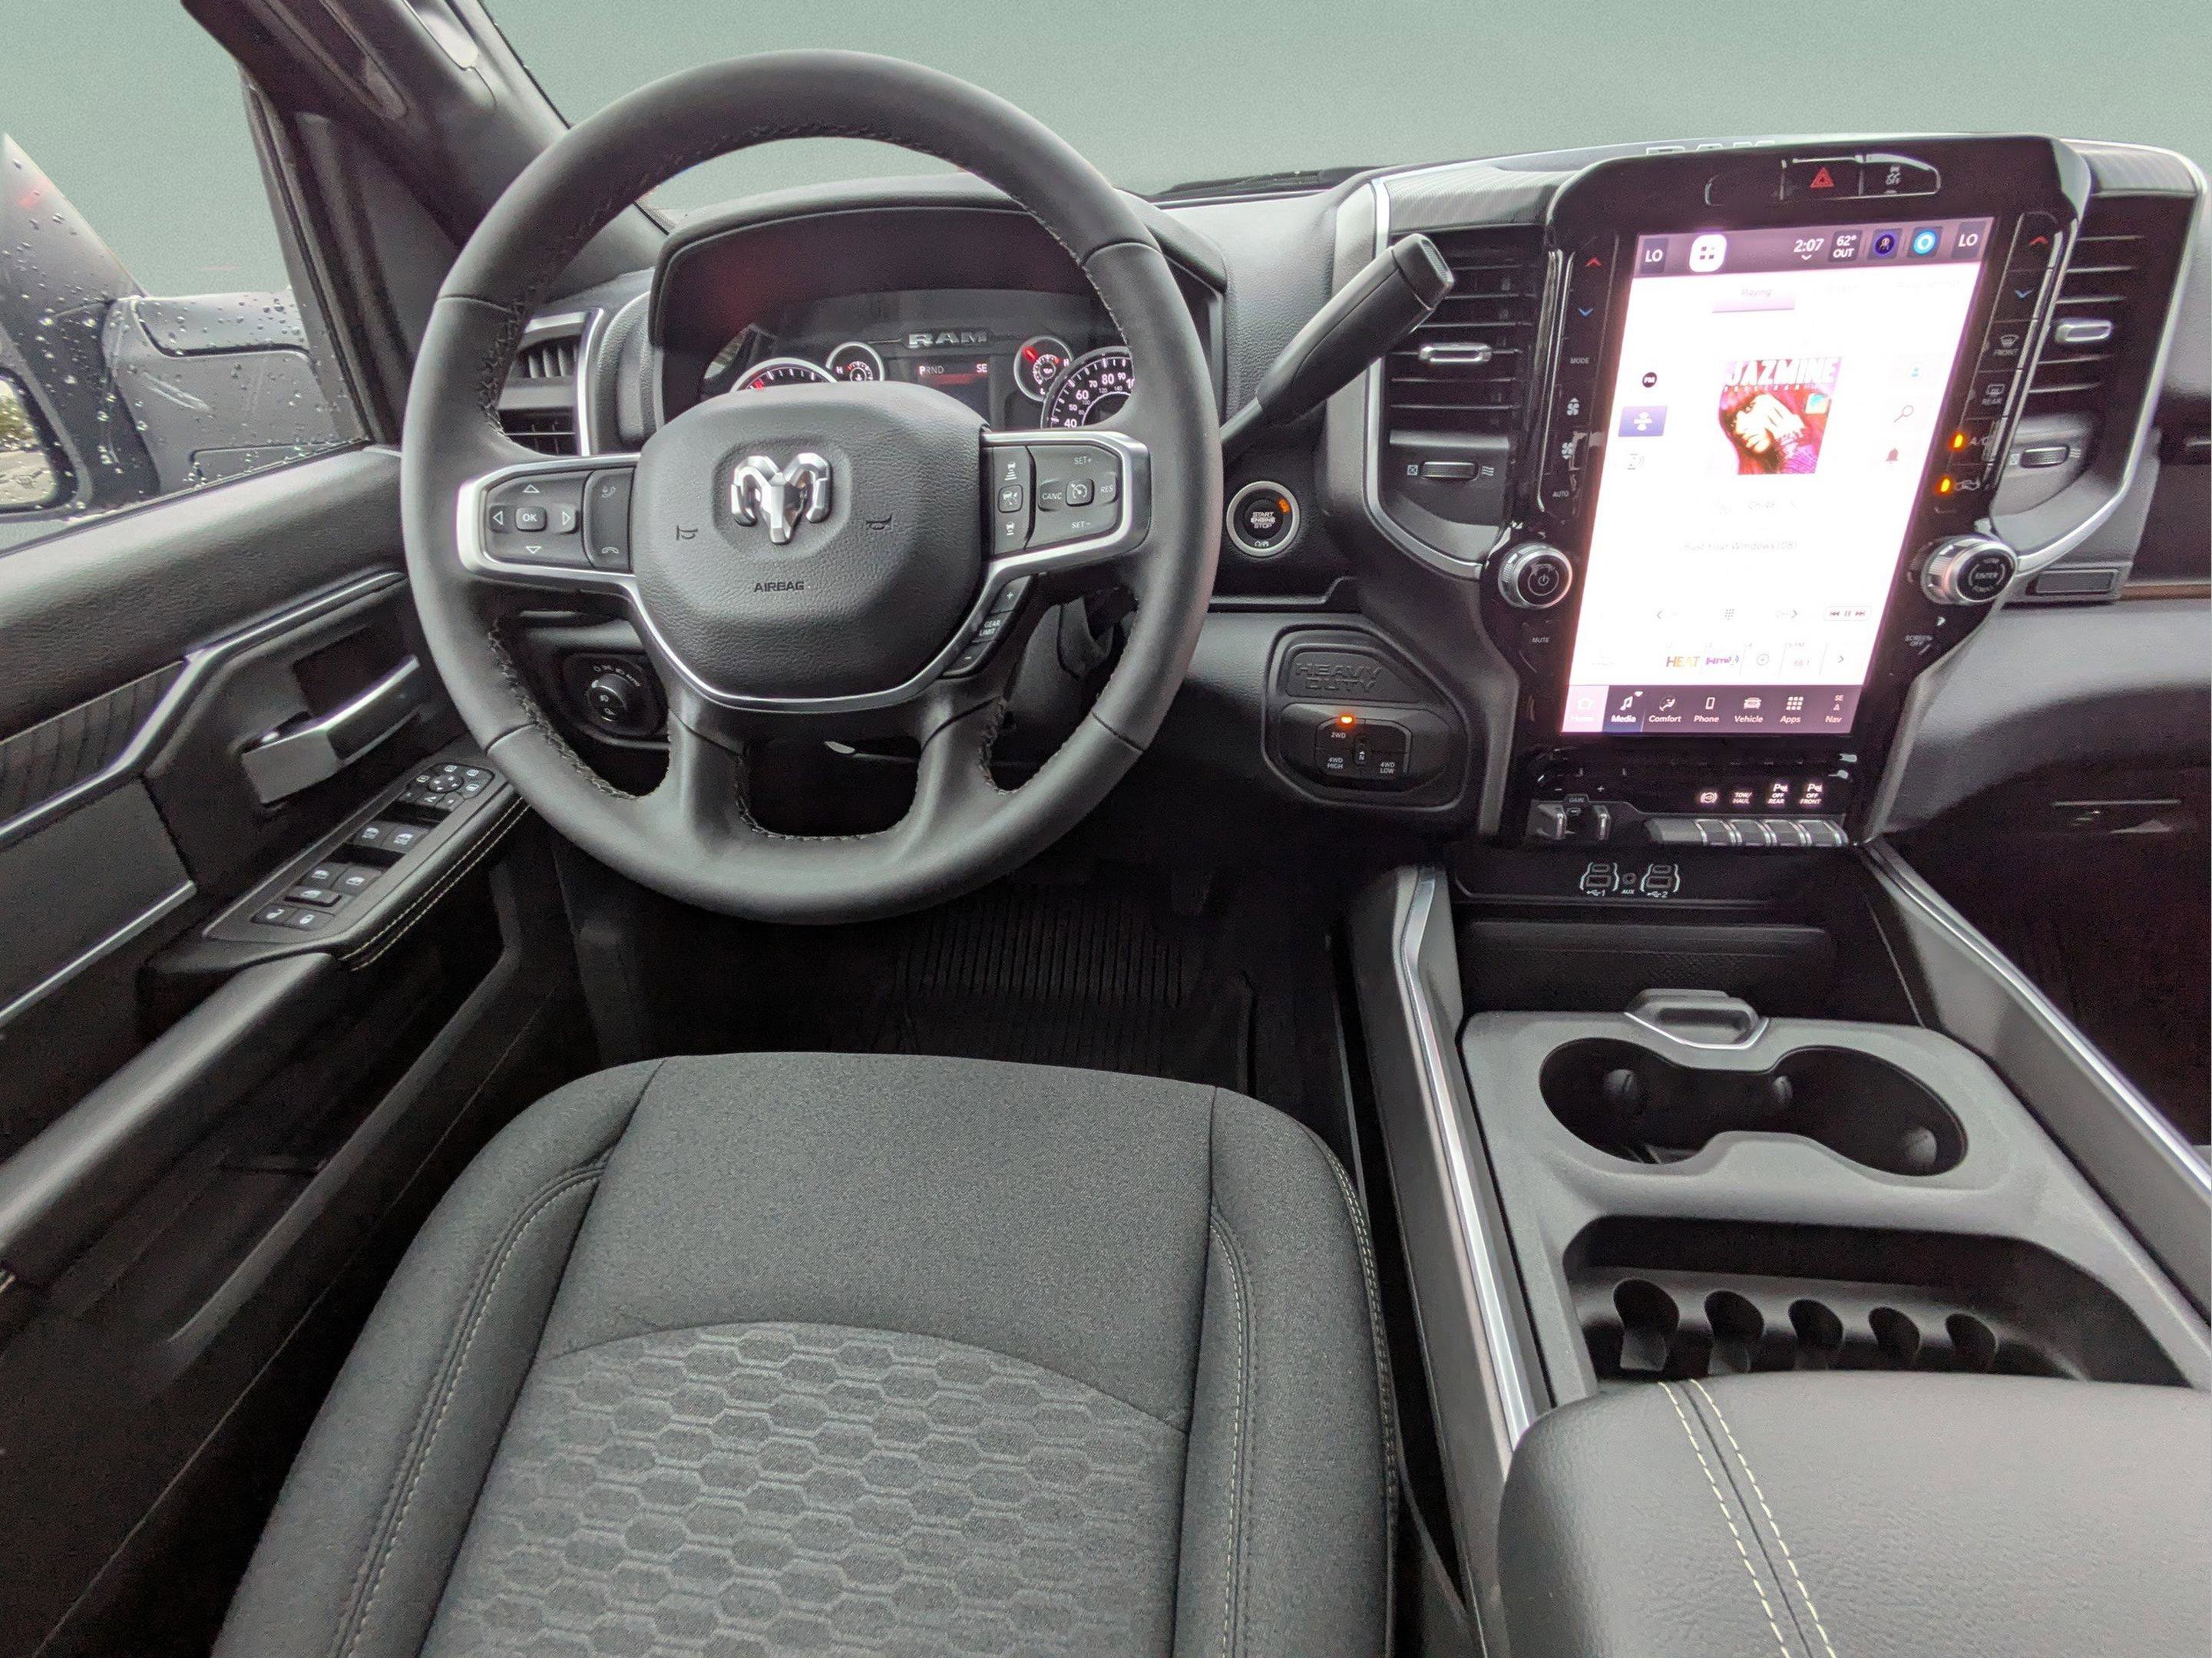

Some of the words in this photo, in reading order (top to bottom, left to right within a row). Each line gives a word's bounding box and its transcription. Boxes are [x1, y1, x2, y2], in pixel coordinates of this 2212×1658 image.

[1794, 238, 1825, 253] 2:07
[1958, 233, 1979, 247] LO
[1645, 249, 1664, 263] LO
[1833, 248, 1854, 259] OUT
[908, 332, 987, 345] RAM
[976, 362, 988, 373] SE
[1726, 357, 1842, 385] JAZMINE
[1101, 374, 1114, 385] 80
[1117, 372, 1126, 381] 90
[1076, 390, 1089, 401] 60
[1063, 418, 1077, 428] 40
[1099, 484, 1113, 494] RES
[1042, 491, 1063, 500] CANC
[522, 514, 537, 522] OK
[753, 581, 805, 593] AIRBAG
[1665, 656, 1701, 668] HEAT
[1295, 662, 1383, 679] HEAVY
[1305, 677, 1377, 692] DUTY
[1611, 715, 1637, 723] Media
[1648, 715, 1681, 723] Comfort
[1694, 715, 1720, 723] Phone
[1734, 715, 1764, 723] Vehicle
[1780, 715, 1801, 725] Apps
[1825, 715, 1843, 723] Nav
